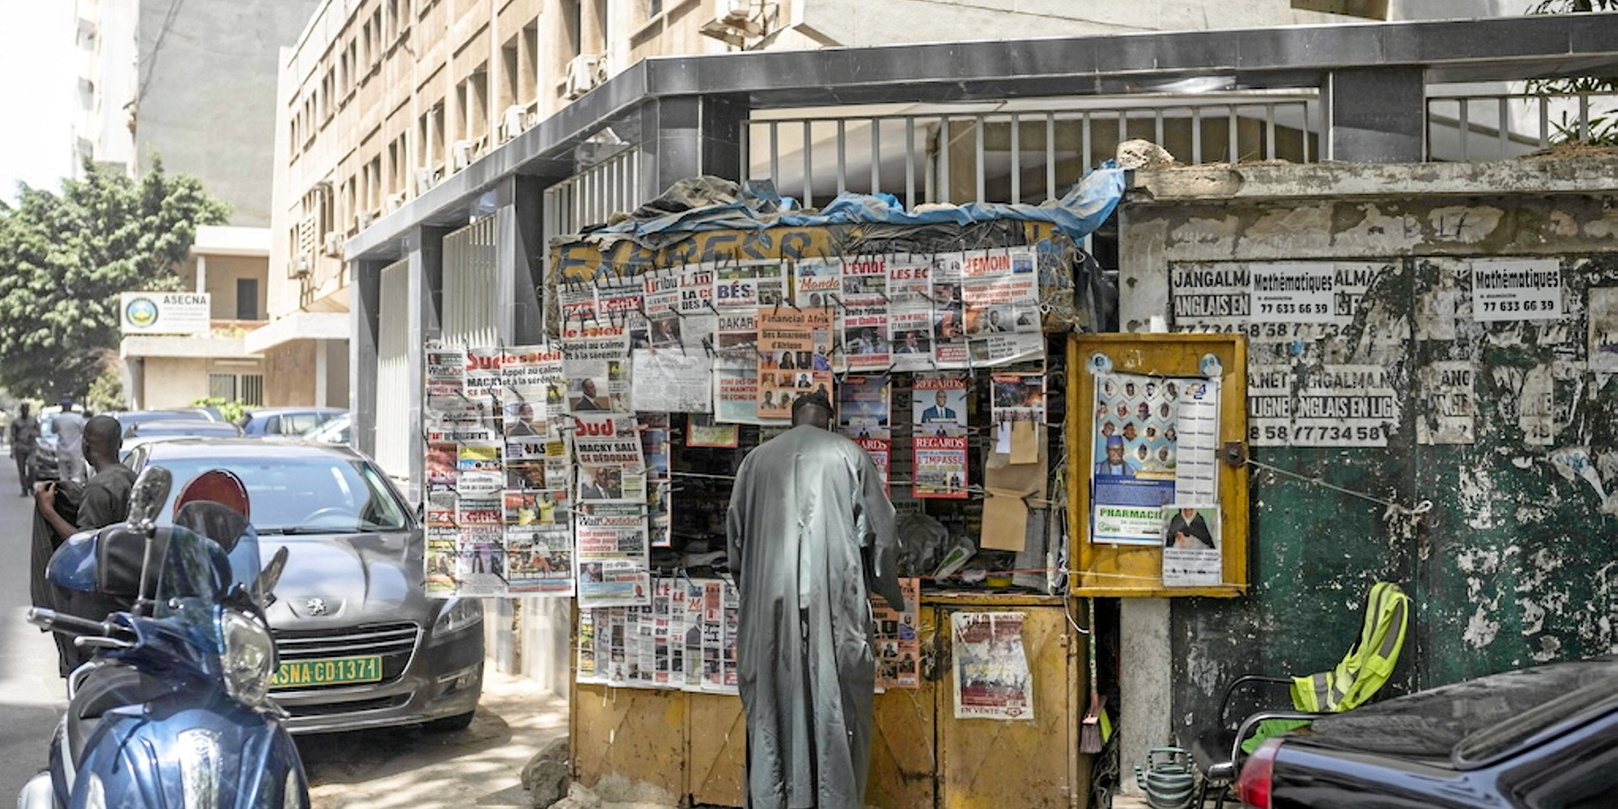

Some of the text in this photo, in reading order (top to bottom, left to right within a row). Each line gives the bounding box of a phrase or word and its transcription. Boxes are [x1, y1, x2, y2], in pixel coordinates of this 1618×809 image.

[890, 268, 910, 280] LES
[1476, 269, 1559, 290] Mathématiques
[1254, 272, 1332, 294] Mathématiques
[163, 295, 206, 305] ASECNA
[1176, 295, 1249, 317] ANGLAIS EN
[1483, 300, 1554, 312] 77 633 66 39
[1261, 304, 1328, 314] 77 633 66 39
[762, 314, 804, 323] Financial
[1266, 324, 1288, 336] 58
[502, 368, 526, 377] Appel
[1252, 398, 1290, 417] LIGNE
[1299, 398, 1348, 417] NGLAIS
[1351, 398, 1368, 417] EN
[574, 418, 614, 436] Sud
[1266, 426, 1288, 440] 58
[1318, 426, 1352, 440] 734
[1357, 426, 1380, 440] 58
[578, 442, 637, 452] MACKY SALL
[916, 438, 964, 448] REGARDS
[580, 454, 591, 462] SE
